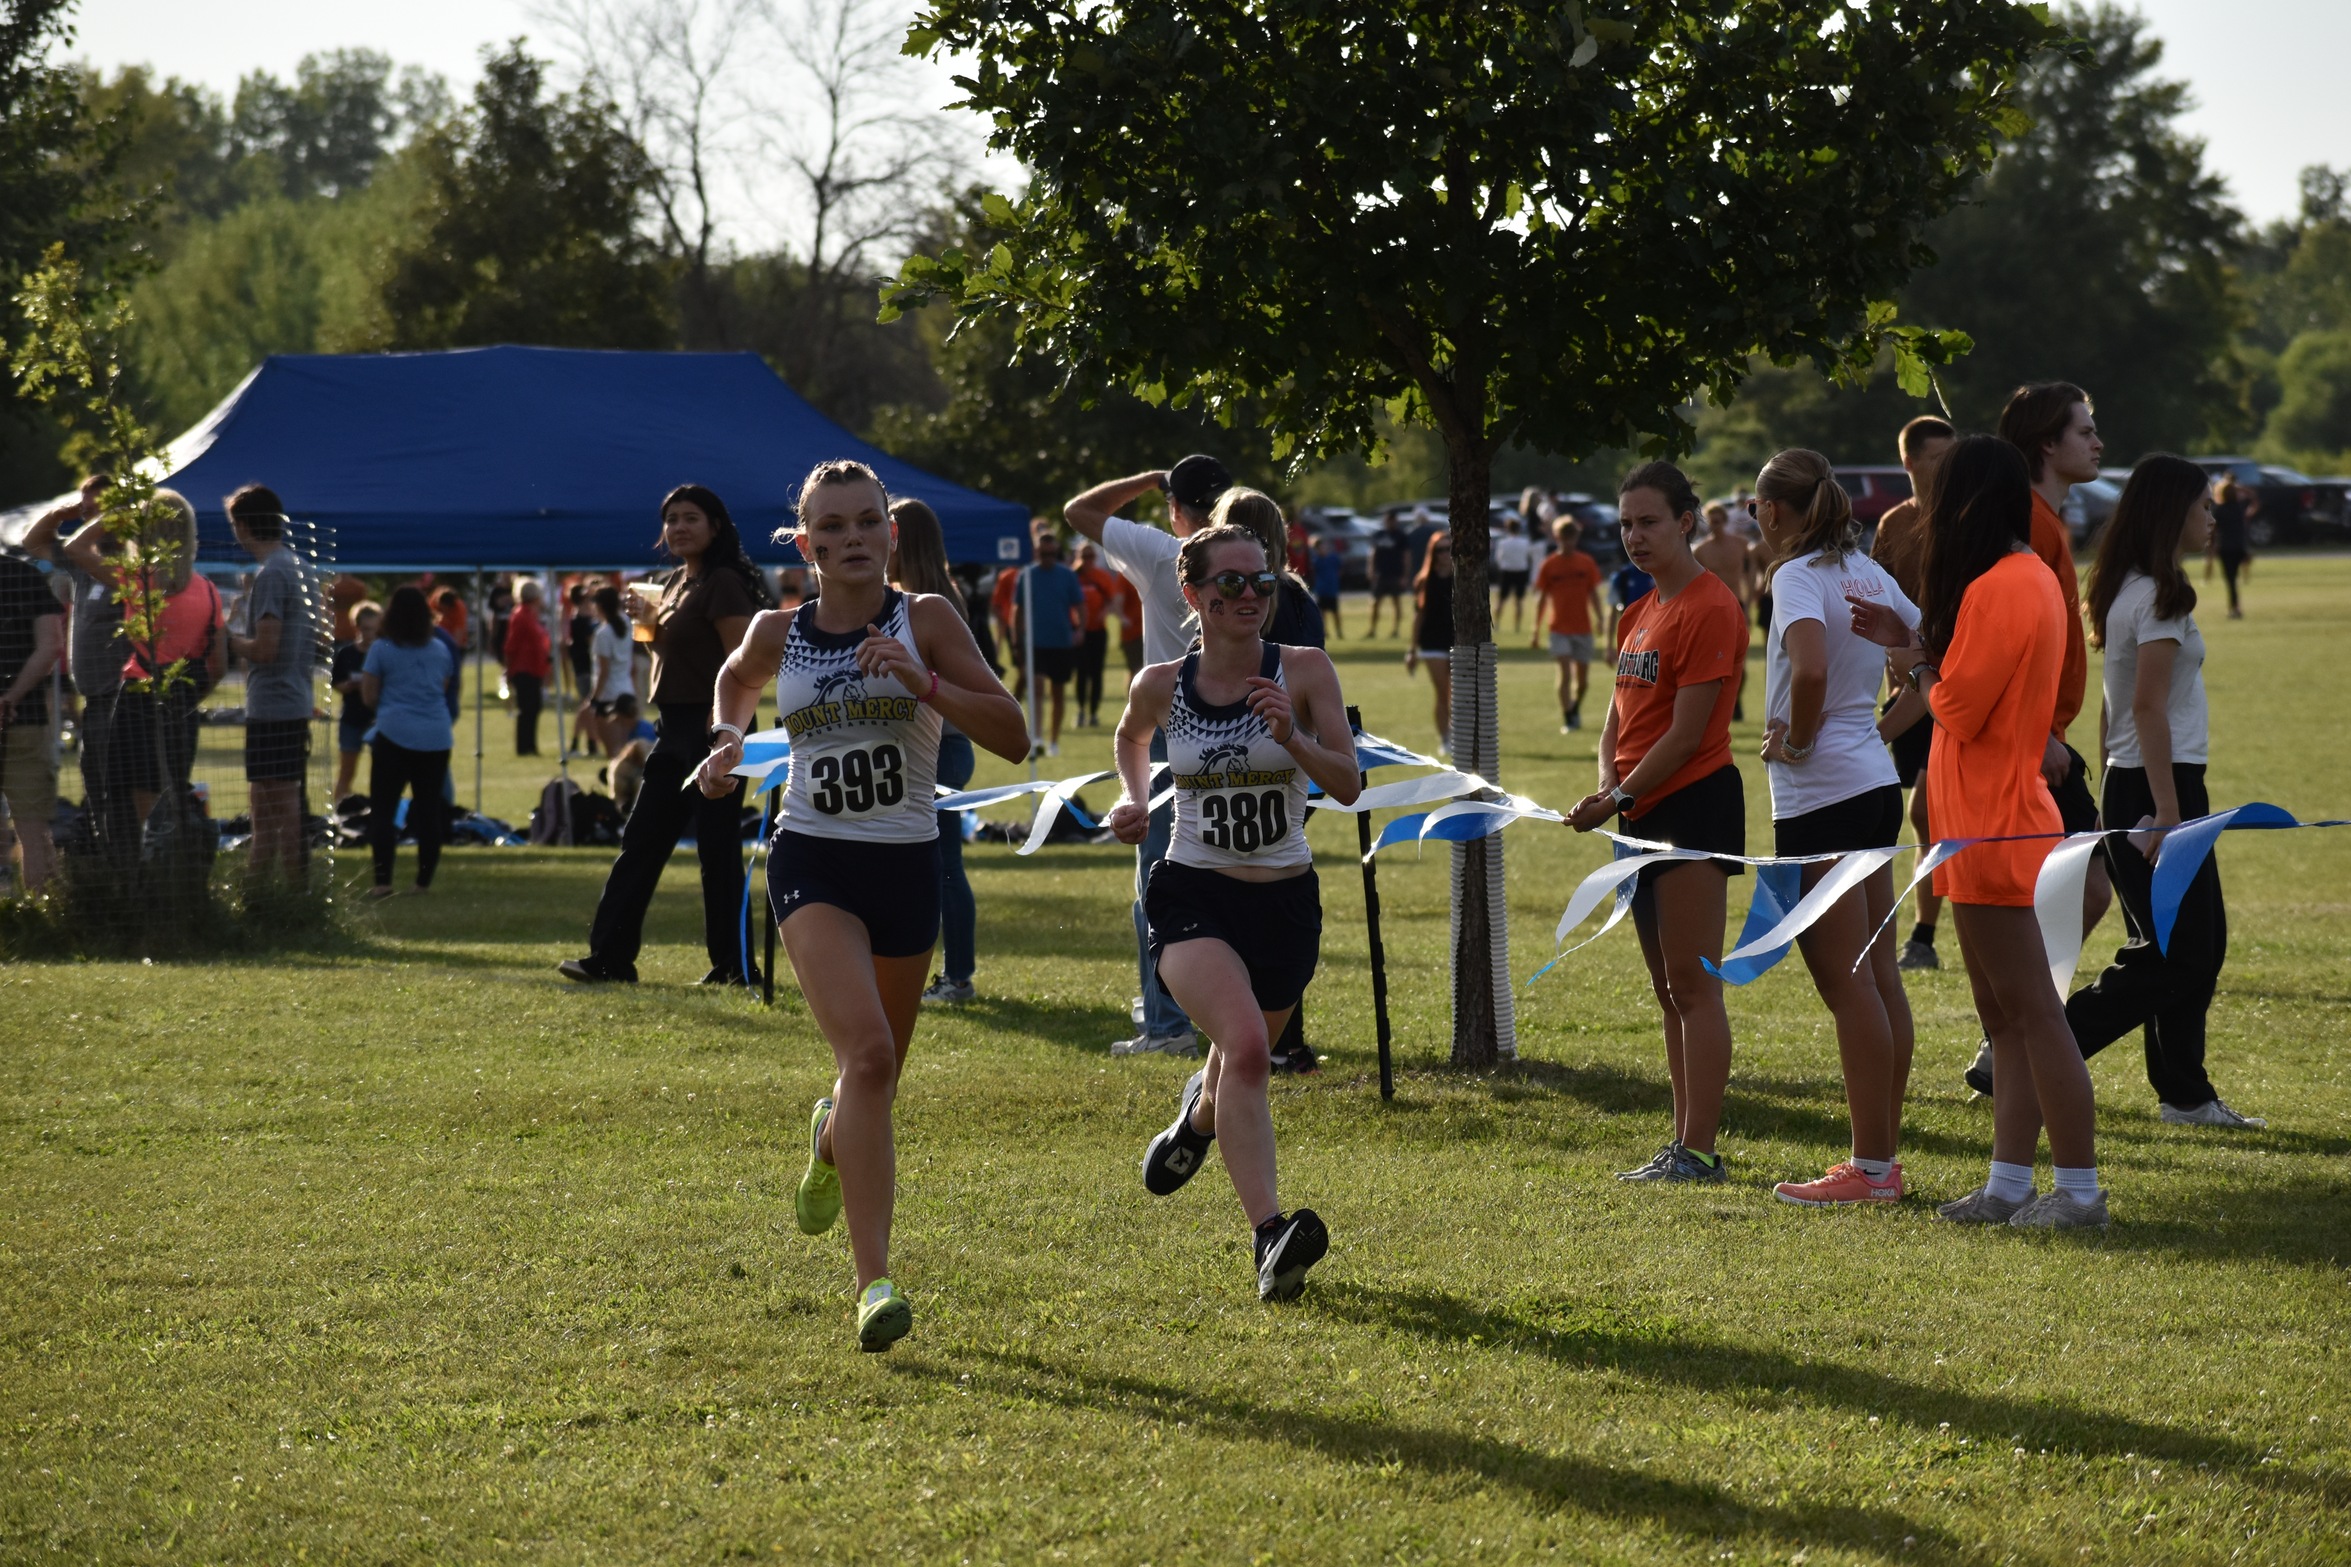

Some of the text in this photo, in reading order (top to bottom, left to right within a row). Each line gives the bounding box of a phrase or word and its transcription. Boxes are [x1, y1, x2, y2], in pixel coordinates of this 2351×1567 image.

[843, 696, 918, 721] MERCY
[806, 720, 889, 737] MUSTANGS
[811, 744, 904, 815] 393
[1227, 768, 1296, 788] MERCY
[1202, 789, 1288, 853] 380
[1871, 1188, 1895, 1198] HOKA
